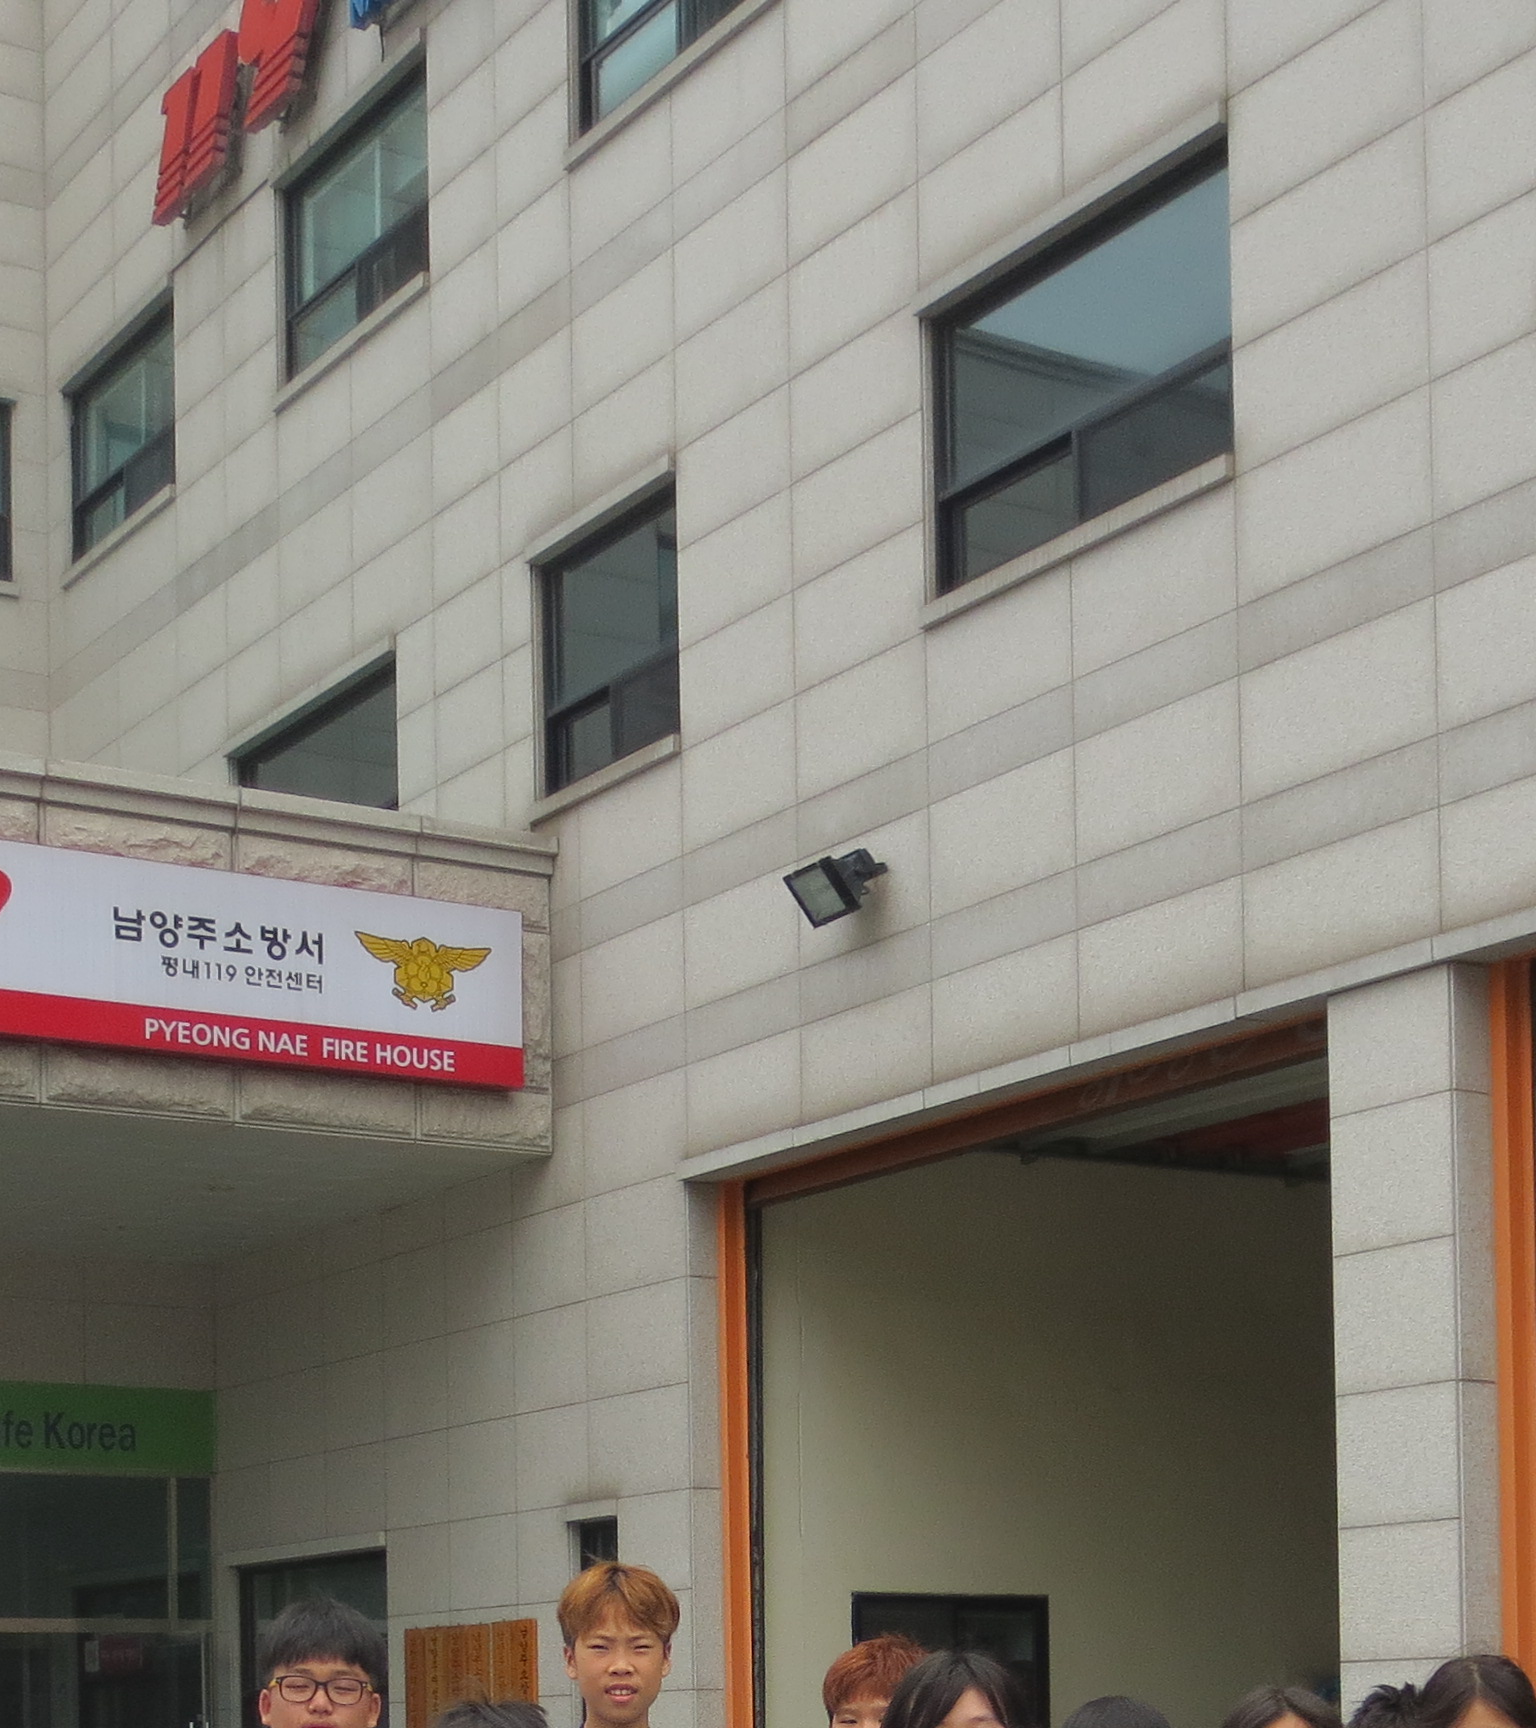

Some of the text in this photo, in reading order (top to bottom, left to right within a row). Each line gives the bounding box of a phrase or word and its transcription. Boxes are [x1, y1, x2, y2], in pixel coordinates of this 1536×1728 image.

[112, 905, 325, 965] 남양주소방서
[161, 954, 324, 994] 평내119 안전센터
[144, 1018, 456, 1073] PYEONG NAE FIRE HOUSE
[44, 1411, 137, 1451] Korea
